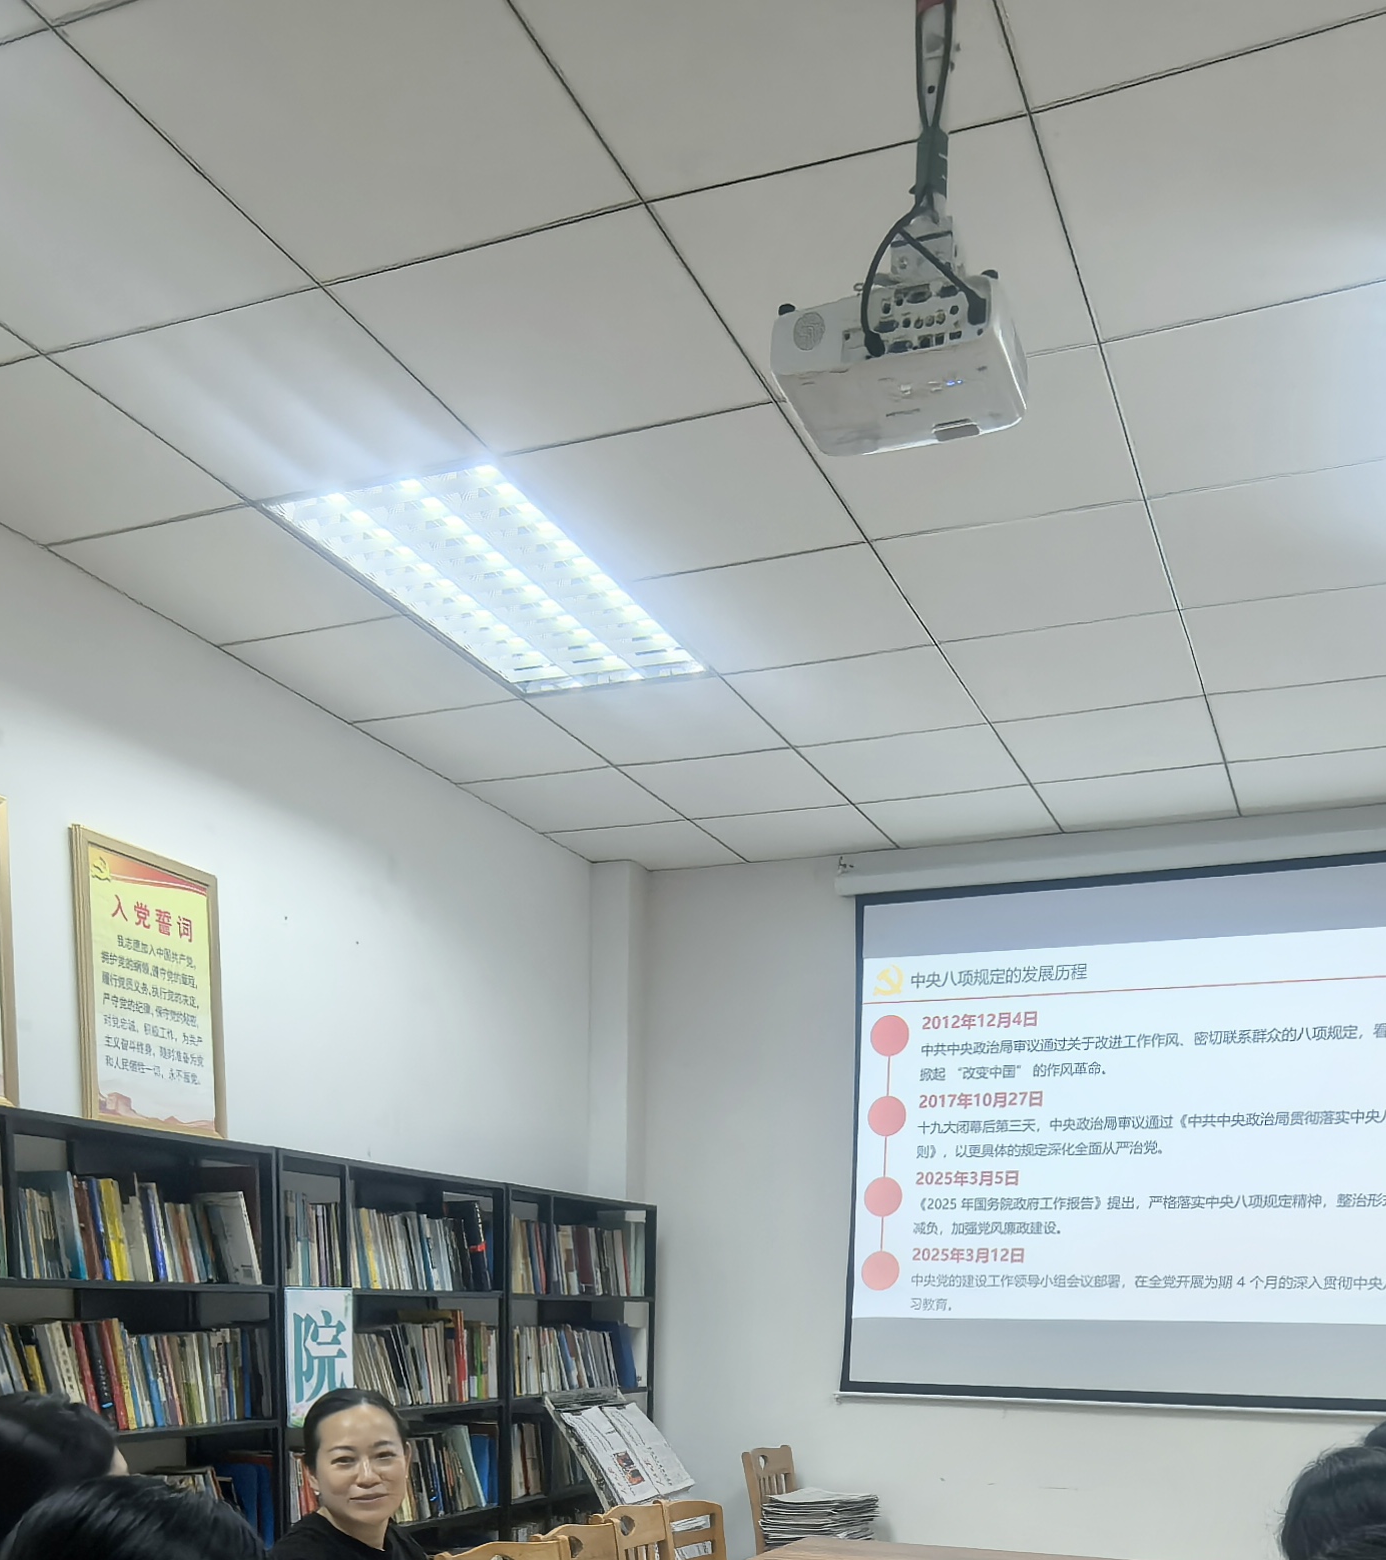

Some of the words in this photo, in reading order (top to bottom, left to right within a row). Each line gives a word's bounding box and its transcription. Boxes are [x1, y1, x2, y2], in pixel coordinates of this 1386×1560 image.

[111, 894, 193, 943] 入党誓词
[910, 963, 1088, 989] 中央八项规定的发展历程
[921, 1011, 1039, 1030] 2012年12月4日
[918, 1090, 1044, 1109] 2017年10月27日
[915, 1170, 1020, 1187] 2025年3月5日
[912, 1221, 1062, 1236] 减负，加强党风廉政建设。
[912, 1247, 1025, 1264] 2025年3月12日
[909, 1297, 953, 1312] 习教育。
[292, 1309, 348, 1404] 院
